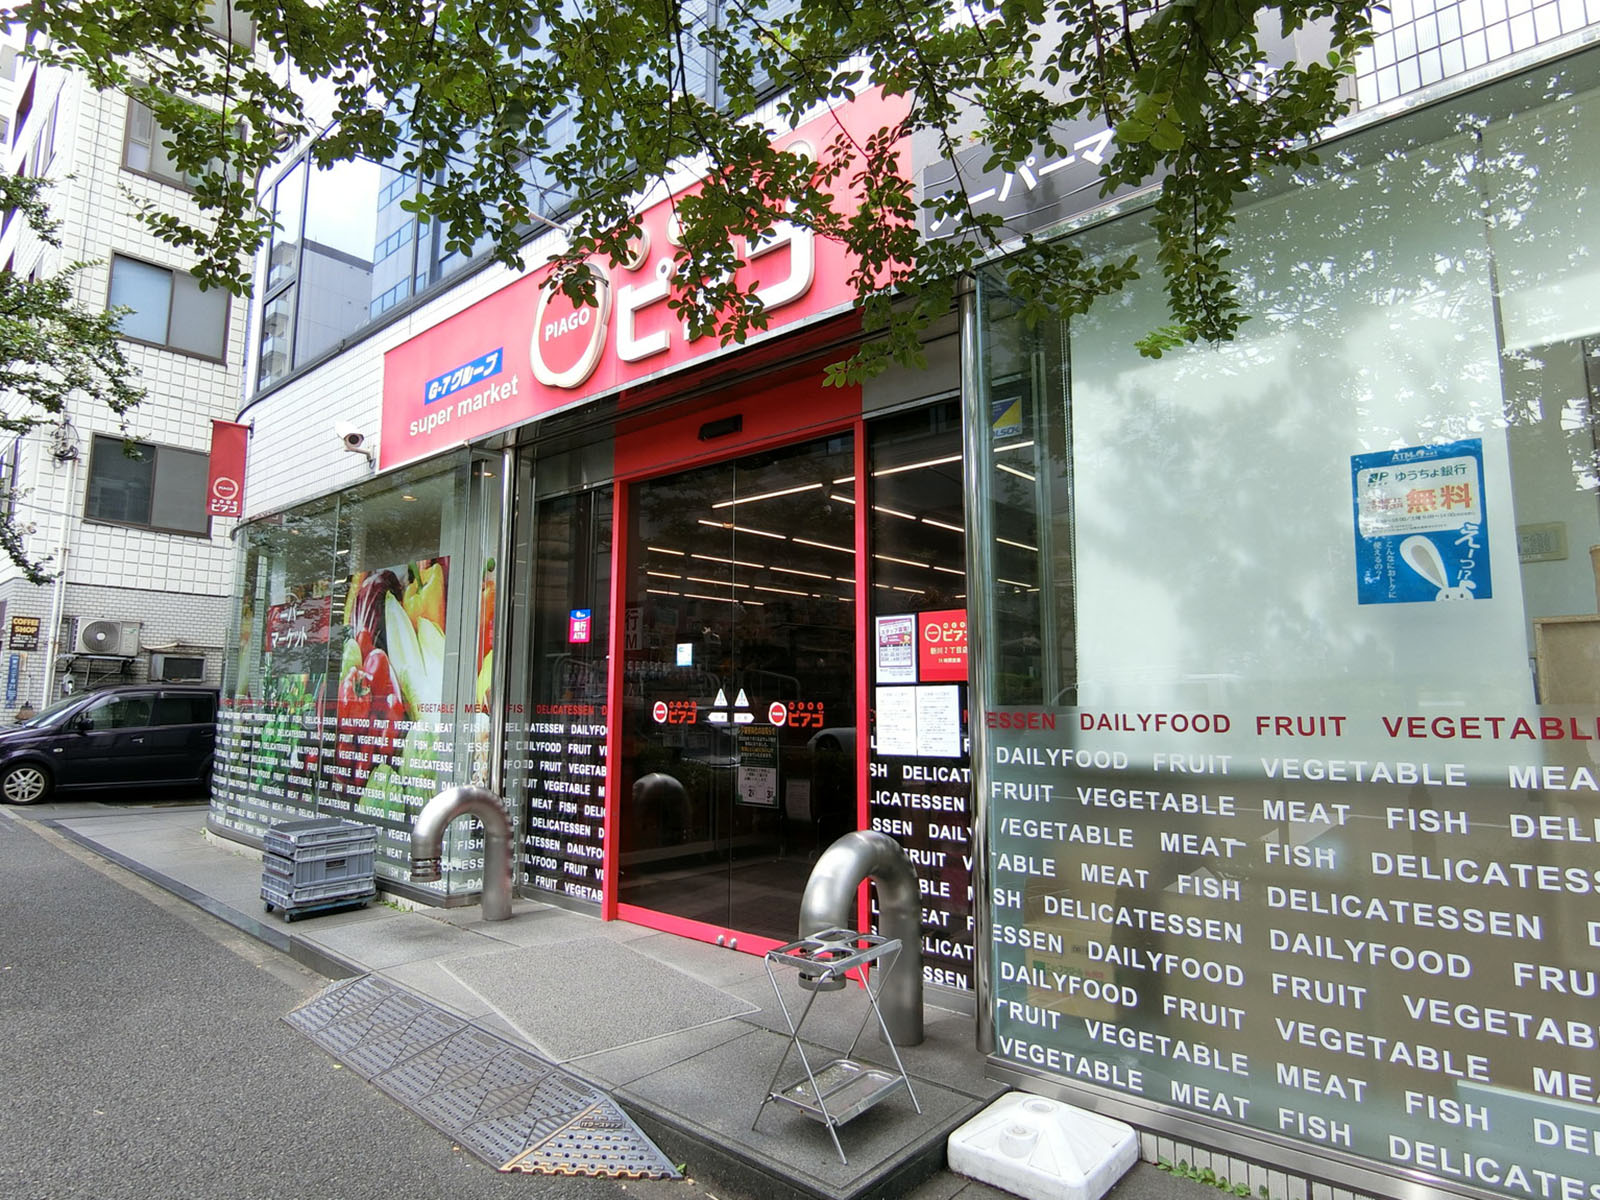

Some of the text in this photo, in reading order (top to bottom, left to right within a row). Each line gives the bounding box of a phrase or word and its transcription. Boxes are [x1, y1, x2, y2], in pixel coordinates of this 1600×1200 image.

[545, 307, 590, 342] PIAGO
[409, 374, 518, 436] super market
[1395, 463, 1468, 481] ゆうちょ銀行
[1406, 483, 1472, 514] 無料
[13, 618, 39, 626] COFFEE
[15, 626, 37, 634] SHOP
[417, 704, 454, 713] VEGETABLE
[506, 704, 525, 713] FIS
[536, 704, 594, 715] DELICATESSEN
[342, 718, 369, 727] DAILYFOOD
[374, 719, 389, 728] FRUIT
[394, 720, 429, 731] VEGETABLE
[435, 723, 452, 732] MEAT
[668, 711, 697, 724] ピアゴ
[788, 712, 824, 728] ピアゴ
[1080, 713, 1231, 733] DAILYFOOD
[1257, 716, 1347, 736] FRUIT
[1382, 717, 1600, 740] VEGETABL
[357, 735, 389, 746] VEGETABLE
[339, 750, 369, 761] VEGETABLE
[372, 753, 388, 764] MEAT
[568, 744, 592, 755] FRUIT
[355, 769, 370, 779] MEAT
[540, 761, 562, 773] FRUIT
[996, 747, 1600, 792] DAILYFOOD FRUIT VEGETABLE MEA
[346, 785, 385, 799] DELICATESSEN
[390, 792, 424, 807] DAILYFOOD
[544, 780, 590, 796] VEGETABLE
[318, 796, 350, 811] ELICATESSEN
[389, 811, 405, 822] FRUIT
[532, 798, 553, 810] MEAT
[559, 801, 577, 813] FISH
[991, 781, 1054, 803] FRUIT
[1077, 787, 1236, 817] VEGETABLE
[1263, 799, 1350, 826] MEAT
[1386, 807, 1468, 834] FISH
[532, 816, 591, 838] DELICATESSEN
[872, 818, 913, 836] SSEN
[458, 838, 484, 851] FISH
[1160, 832, 1238, 858] MEAT
[1264, 843, 1336, 870] FISH
[387, 847, 402, 859] MEAT
[563, 862, 588, 877] FRUIT
[536, 875, 557, 890] FRUIT
[991, 852, 1541, 941] ABLE MEAT FISH DELICATESSEN
[1044, 895, 1242, 944] DELICATESSEN
[1270, 929, 1472, 979] DAILYFOOD
[1513, 962, 1597, 997] FRU
[992, 923, 1063, 954] ESSEN
[1088, 940, 1245, 987] DAILYFOOD
[1272, 973, 1367, 1009] FRUIT
[1001, 961, 1138, 1008] DAILYFOOD
[1163, 995, 1246, 1030] FRUIT
[1275, 1017, 1489, 1082] VEGETABLE
[1532, 1067, 1600, 1103] ME
[1085, 1018, 1249, 1076] VEGETABLE
[1276, 1063, 1367, 1102] MEAT
[1405, 1090, 1489, 1132] FISH
[999, 1035, 1144, 1092] VEGETABLE
[1171, 1081, 1250, 1119] MEAT
[1278, 1107, 1351, 1147] FISH
